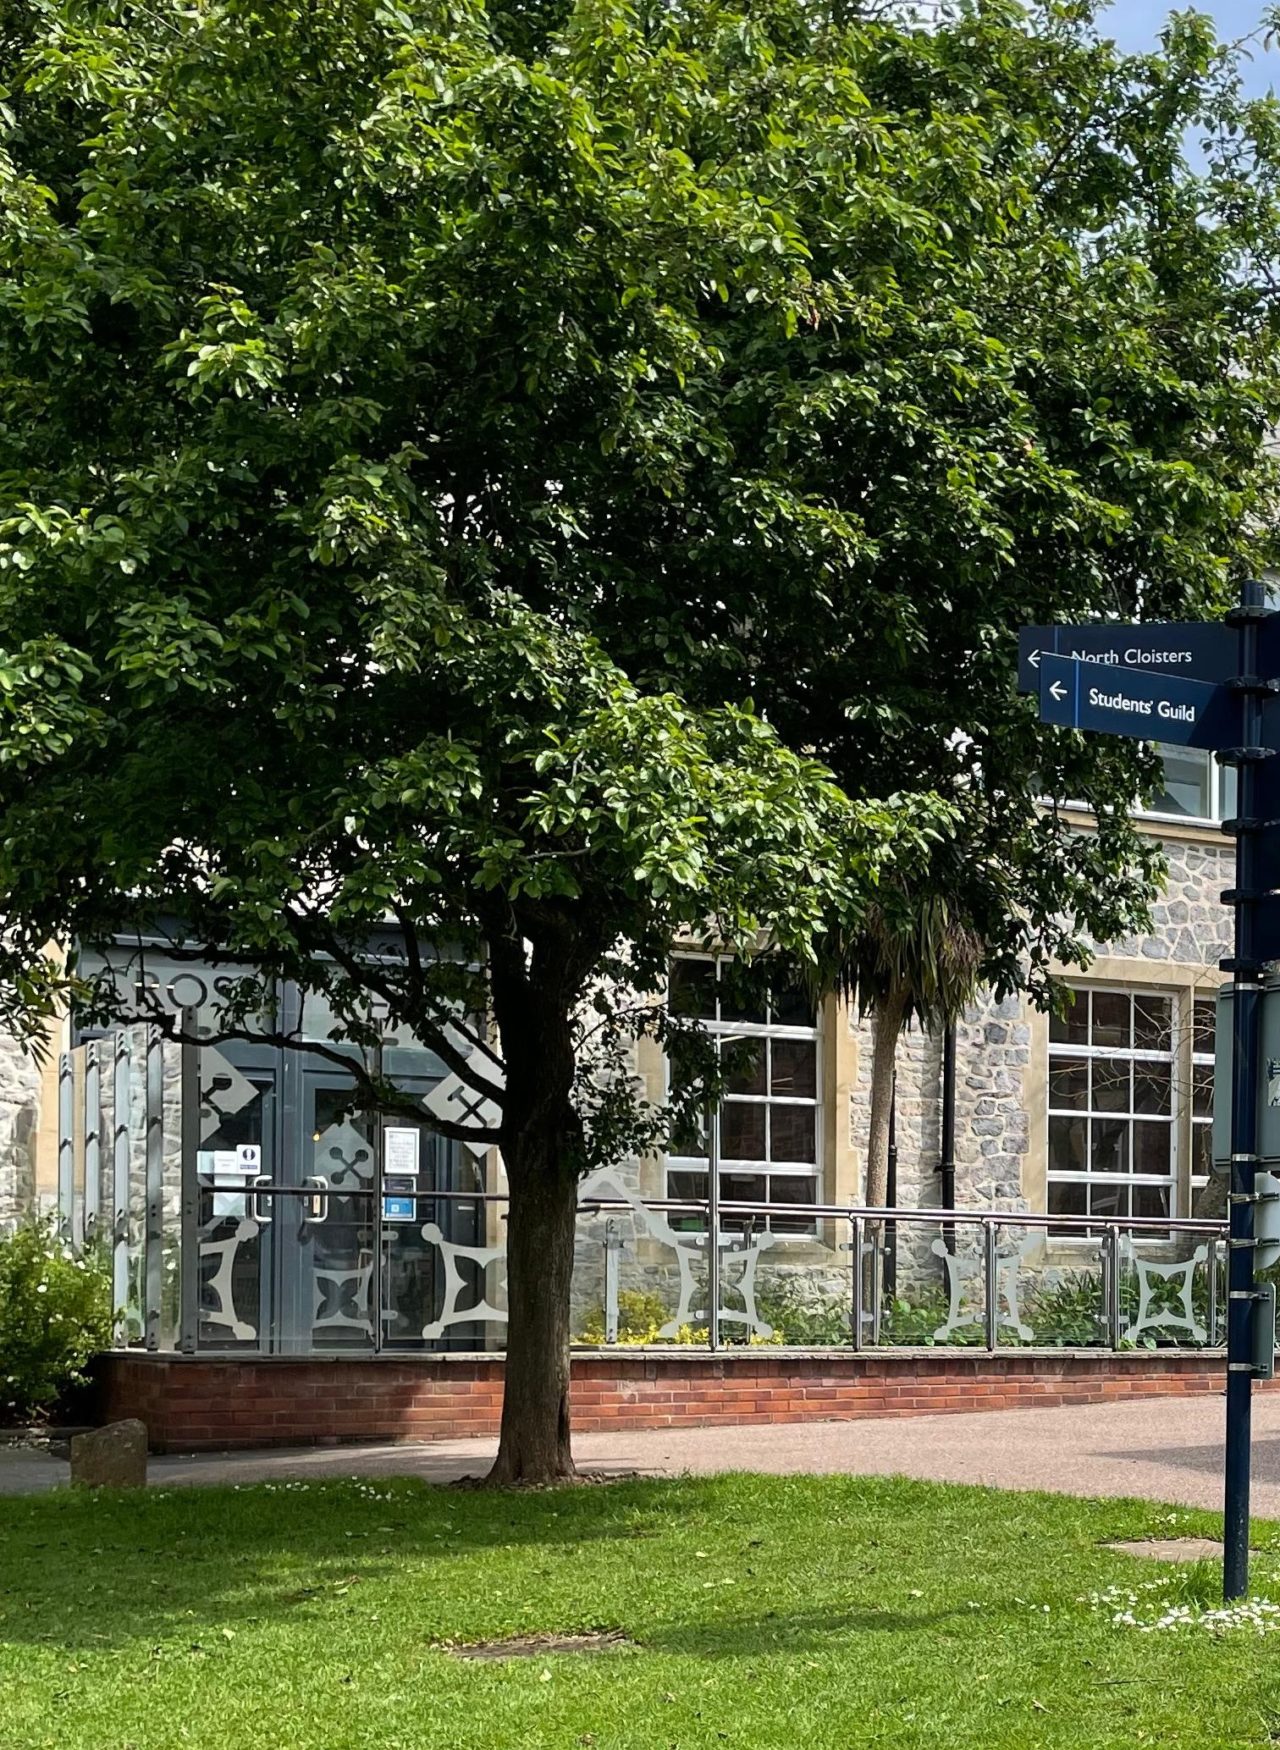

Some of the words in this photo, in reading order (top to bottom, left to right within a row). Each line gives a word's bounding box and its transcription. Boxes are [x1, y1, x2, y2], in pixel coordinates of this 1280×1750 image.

[1071, 650, 1119, 664] North
[1124, 649, 1192, 664] Cloisters
[1158, 701, 1195, 722] Guild
